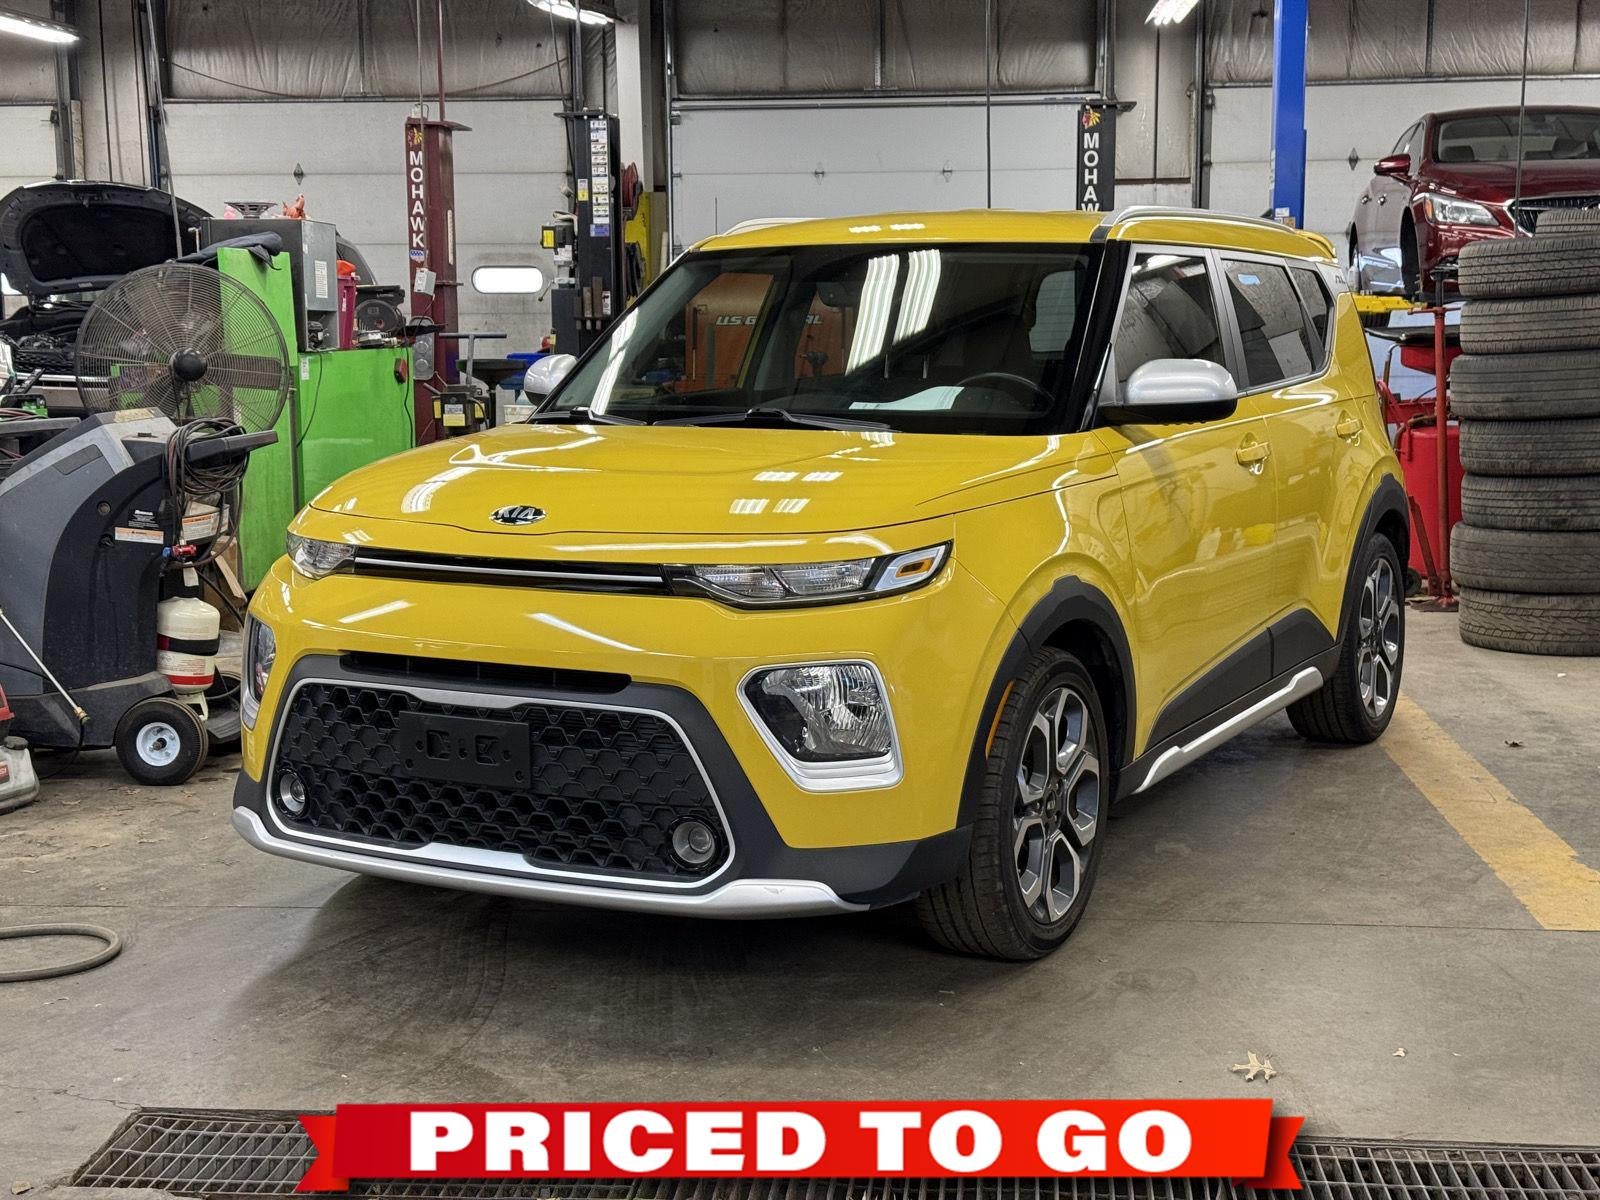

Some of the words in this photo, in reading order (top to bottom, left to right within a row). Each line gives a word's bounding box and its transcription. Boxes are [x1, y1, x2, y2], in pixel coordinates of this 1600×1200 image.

[409, 151, 425, 248] MOHAWK
[1081, 132, 1100, 212] MOHAW
[494, 505, 538, 520] KIA
